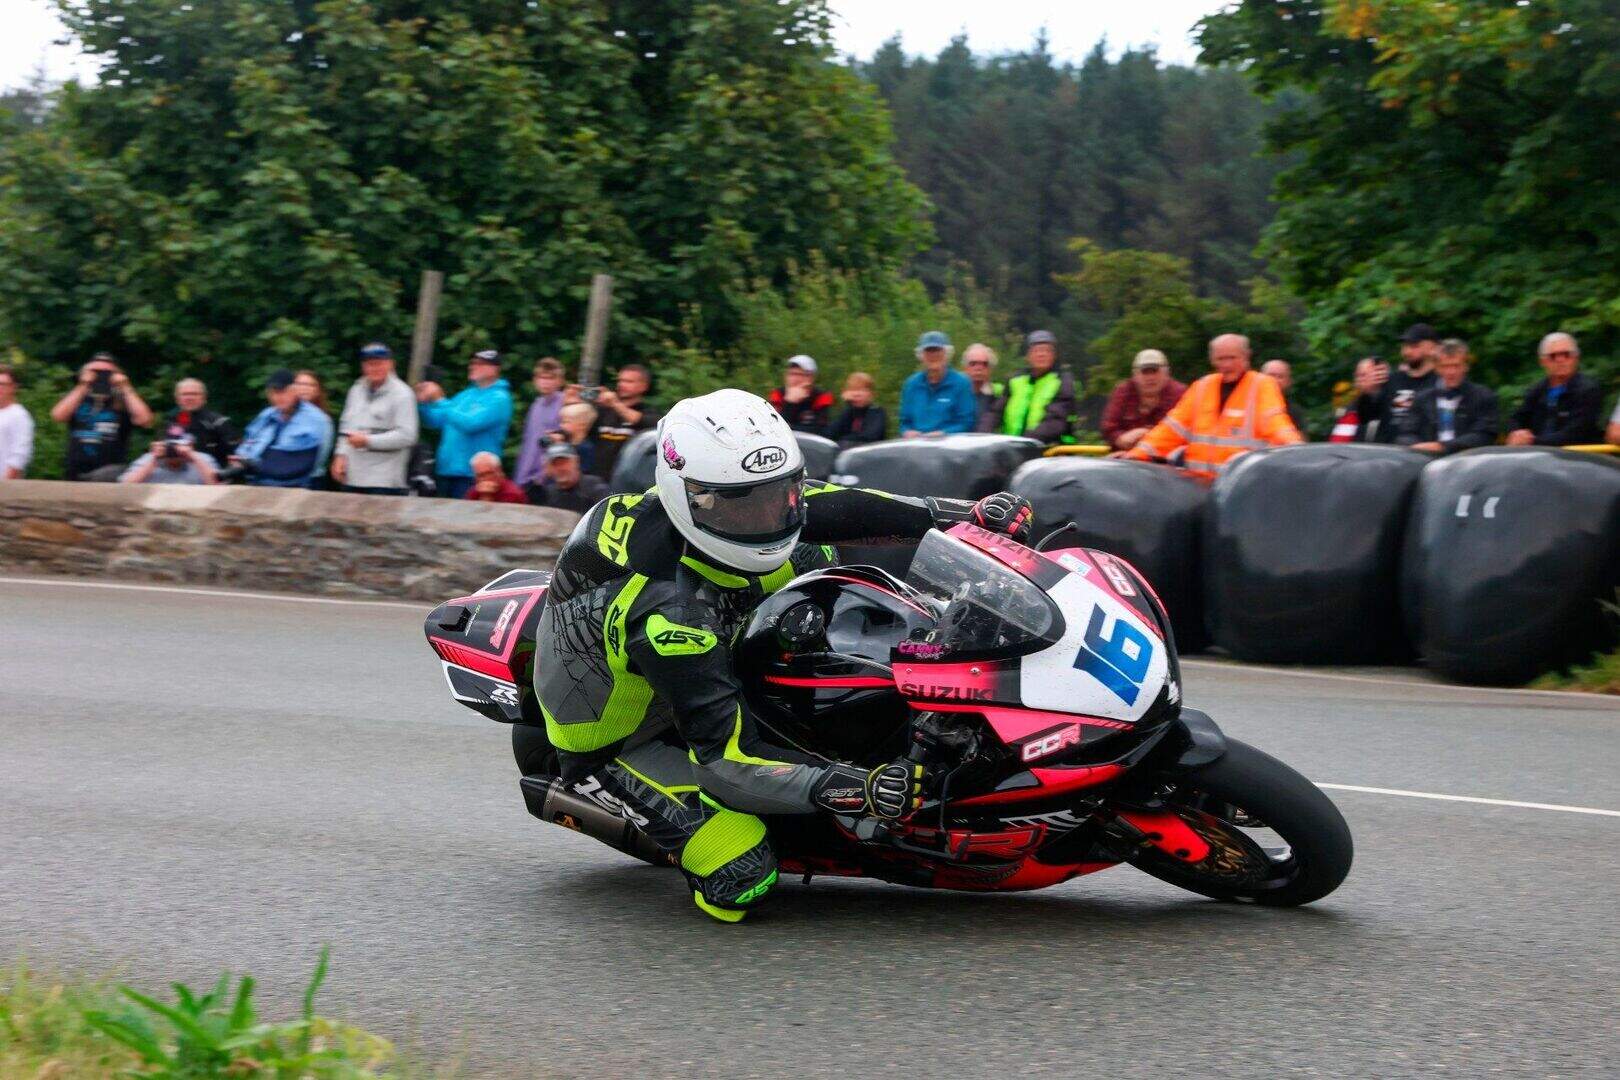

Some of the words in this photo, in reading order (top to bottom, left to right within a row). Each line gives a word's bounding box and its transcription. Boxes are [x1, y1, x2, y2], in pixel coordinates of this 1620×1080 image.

[746, 448, 783, 469] Arai
[607, 604, 624, 658] 4SR
[653, 629, 706, 647] 4SR
[1072, 603, 1154, 707] 16
[1022, 723, 1081, 762] CCR
